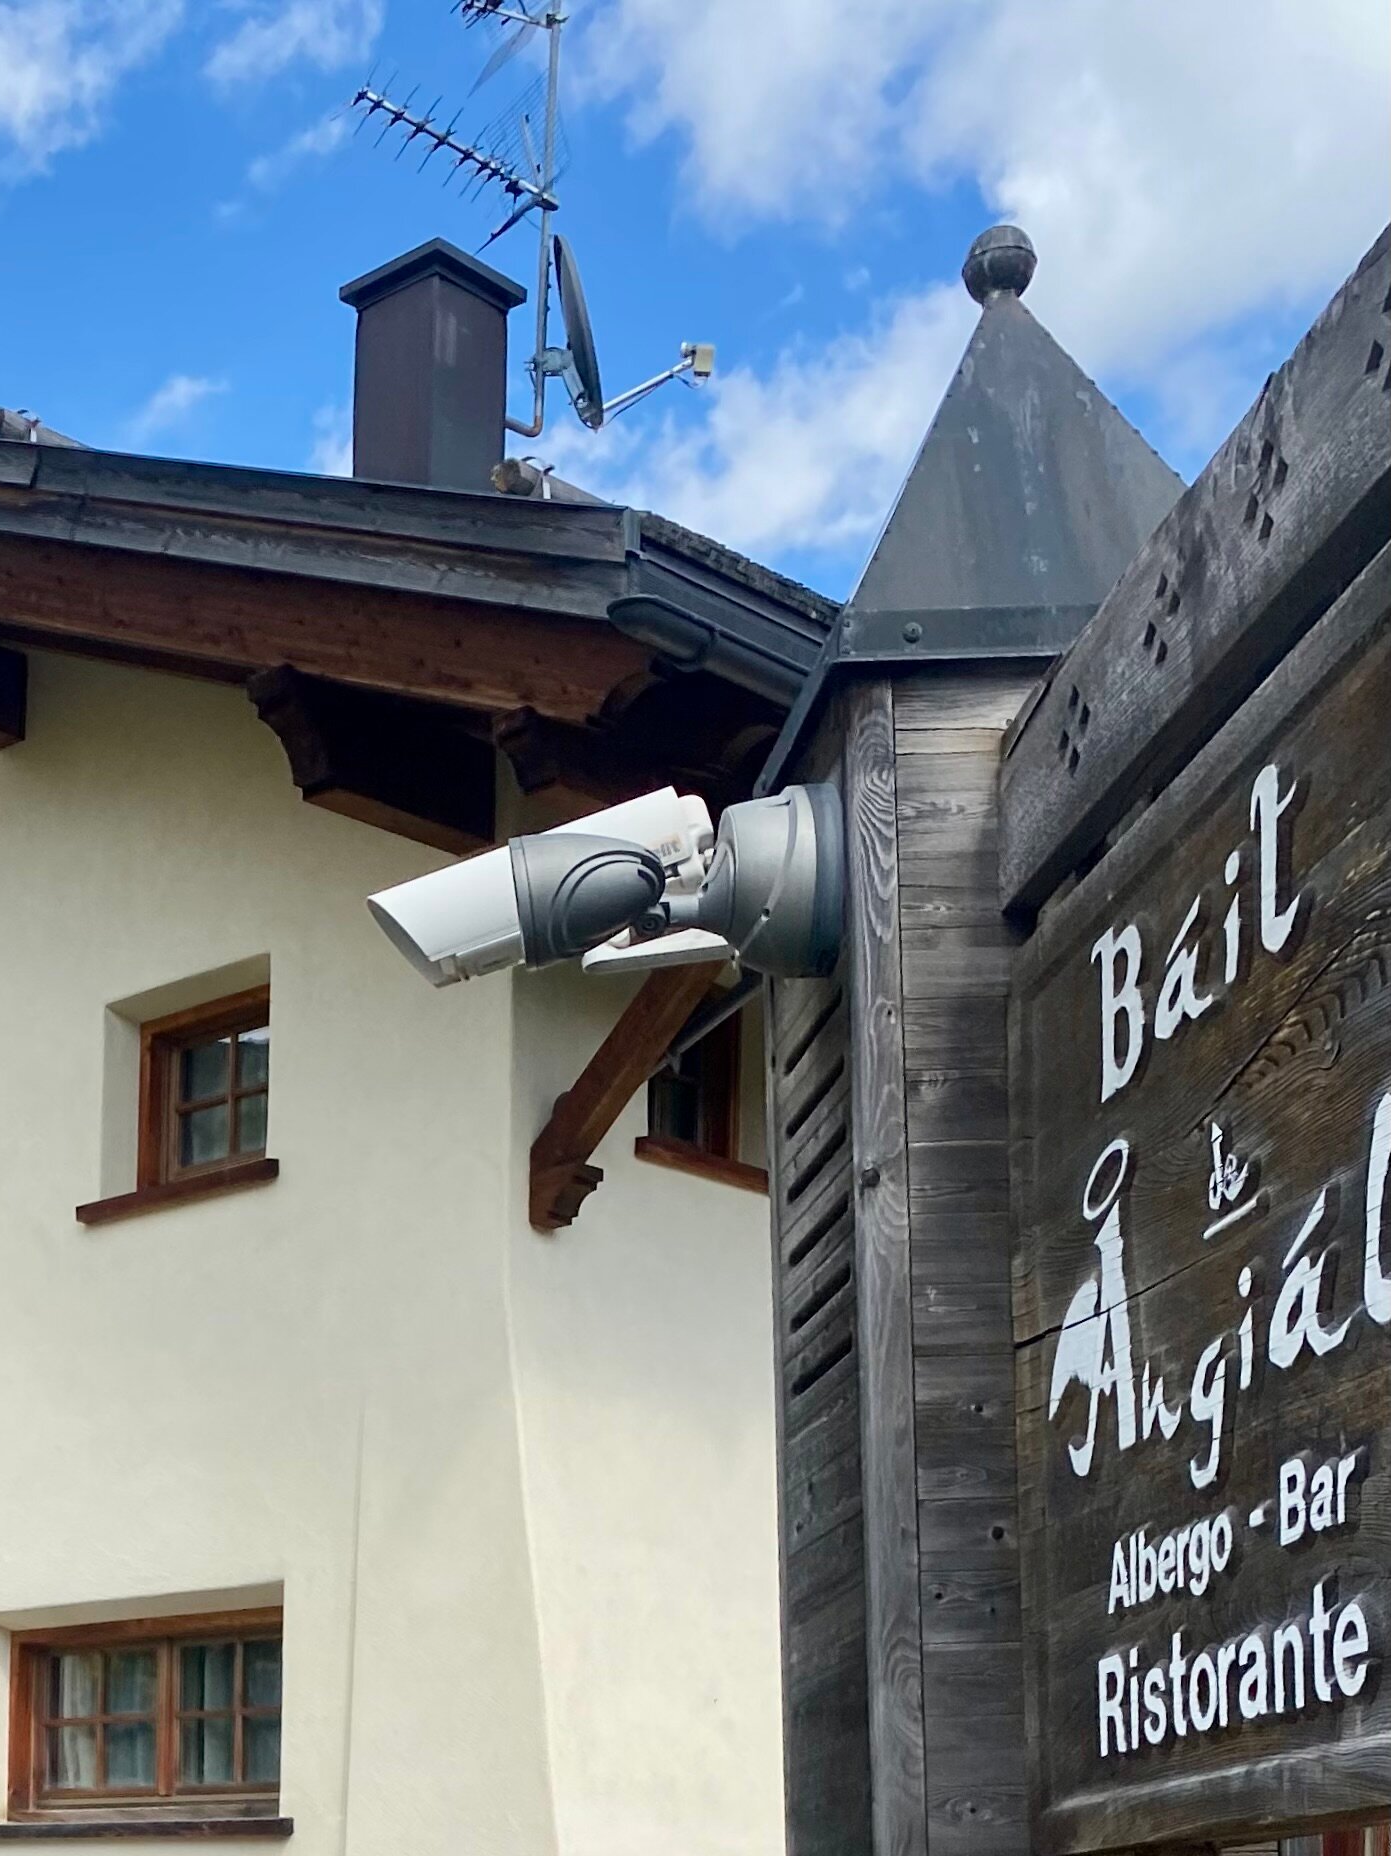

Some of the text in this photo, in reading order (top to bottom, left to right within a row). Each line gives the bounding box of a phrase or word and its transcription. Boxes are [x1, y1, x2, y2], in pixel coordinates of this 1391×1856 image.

[1091, 764, 1301, 1103] Báit
[1209, 1122, 1249, 1210] de
[1108, 1512, 1232, 1614] Albergo
[1278, 1454, 1358, 1547] Bar
[1098, 1582, 1370, 1757] Ristorante
